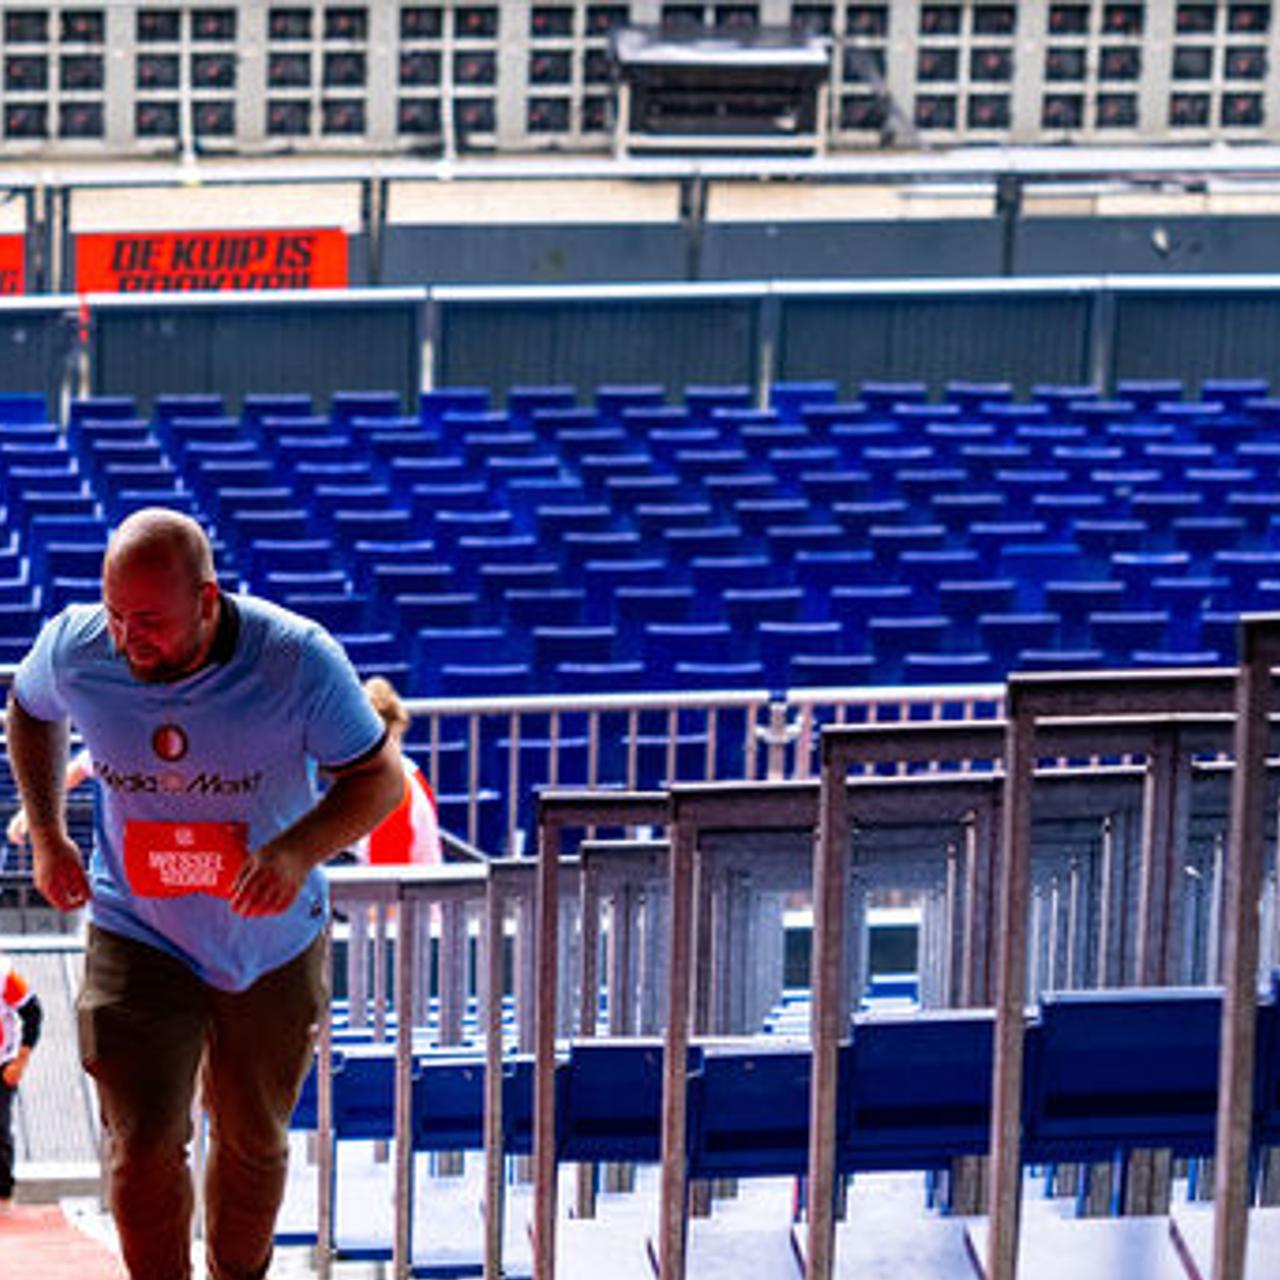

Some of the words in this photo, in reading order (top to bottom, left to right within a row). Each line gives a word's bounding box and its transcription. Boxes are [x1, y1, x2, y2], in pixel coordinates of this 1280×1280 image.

[111, 239, 161, 272] DE
[171, 238, 266, 271] KUIP
[275, 236, 316, 268] IS
